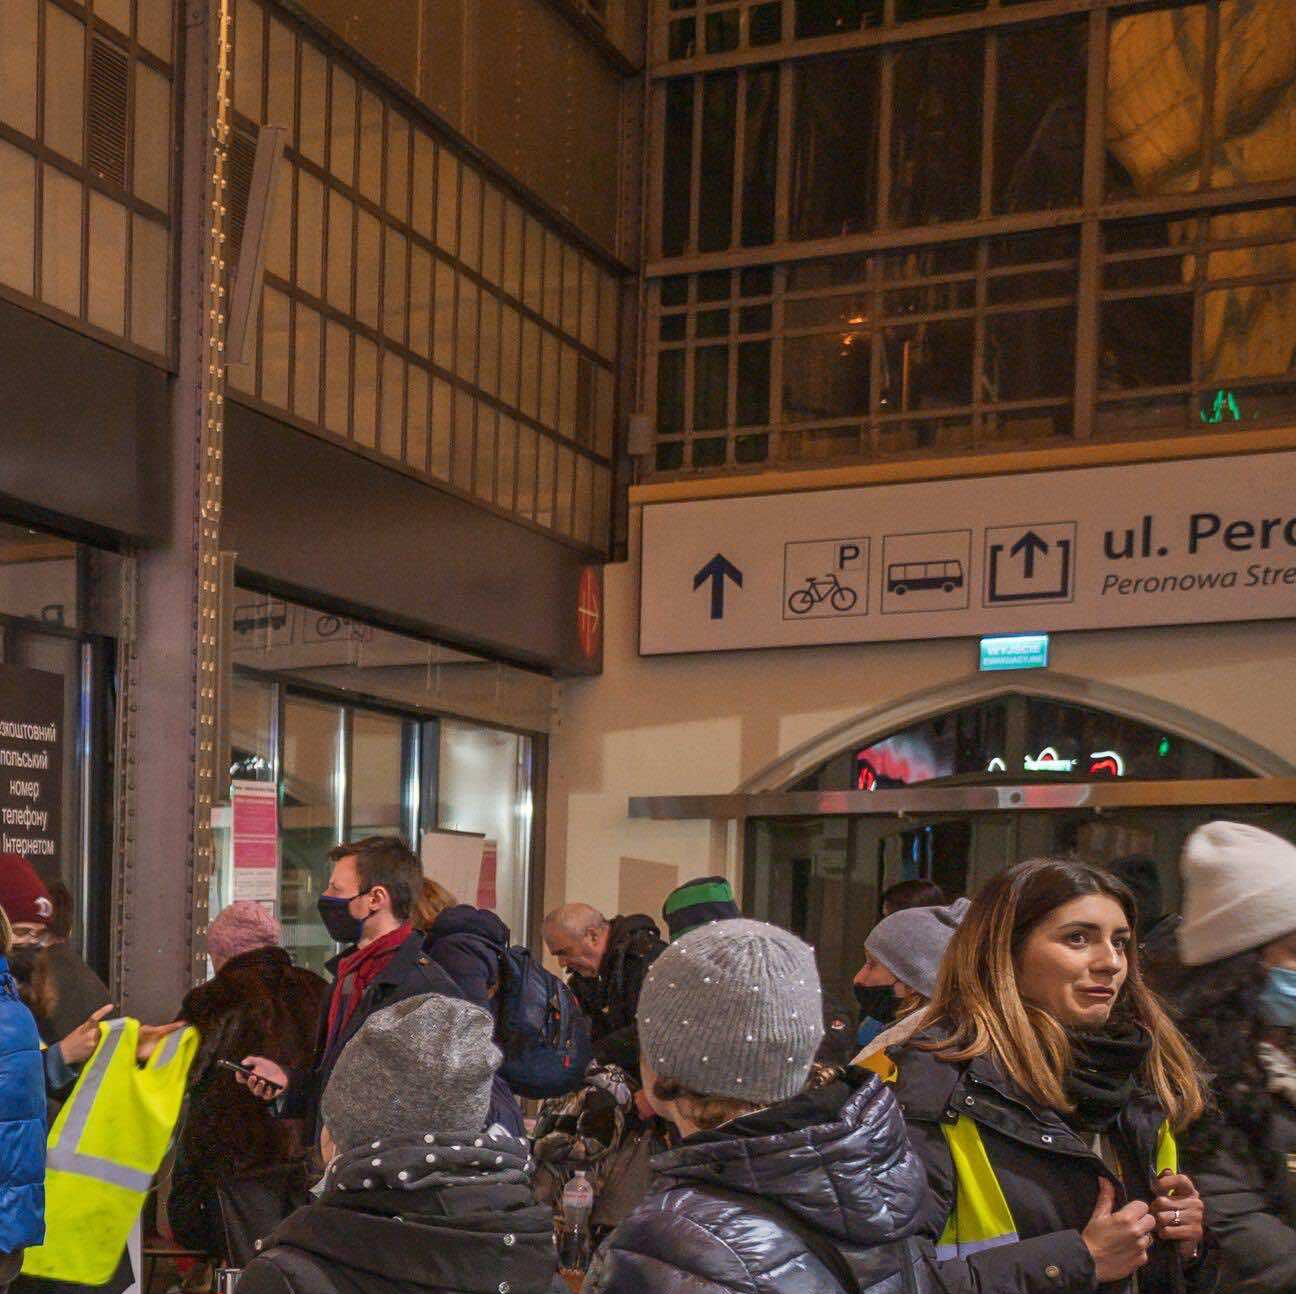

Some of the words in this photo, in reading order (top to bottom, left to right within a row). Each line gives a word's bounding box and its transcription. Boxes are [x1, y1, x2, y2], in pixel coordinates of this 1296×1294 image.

[1104, 515, 1169, 559] ul.
[1101, 570, 1237, 595] Peronowa
[0, 751, 48, 769] польський
[10, 779, 40, 801] номер
[2, 805, 48, 831] телефону
[2, 840, 55, 857] Інтернетом
